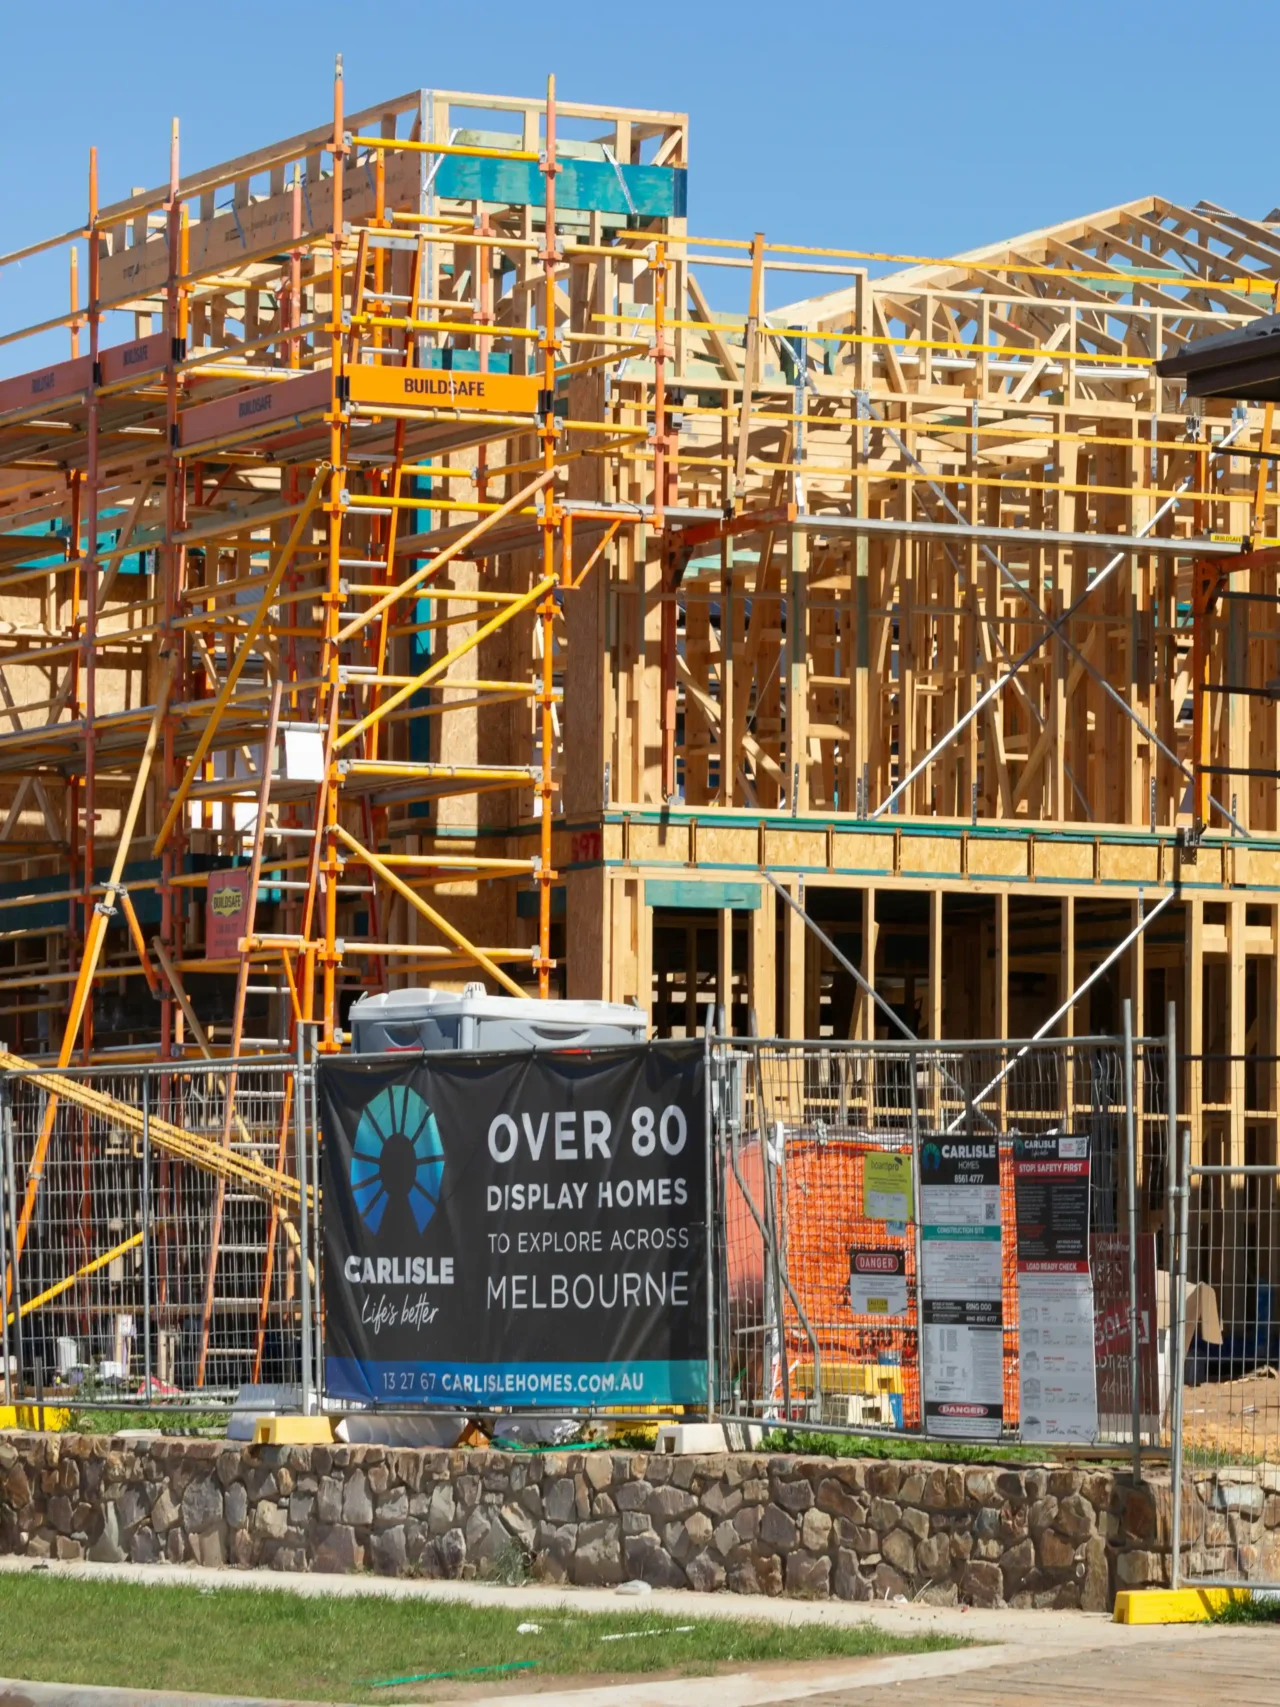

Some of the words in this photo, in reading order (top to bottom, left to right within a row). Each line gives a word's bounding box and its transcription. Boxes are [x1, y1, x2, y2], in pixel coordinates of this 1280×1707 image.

[404, 378, 485, 397] BUILDSAFE
[238, 394, 273, 418] BUILDSAFE
[213, 895, 242, 909] BUILDSAFE
[487, 1110, 612, 1163] OVER
[631, 1104, 687, 1157] 80
[942, 1144, 996, 1159] CARLISLE
[1024, 1140, 1057, 1149] CARLISLE
[958, 1160, 980, 1170] HOMES
[1037, 1163, 1062, 1172] SAFETY
[1063, 1163, 1083, 1172] FIRST
[954, 1174, 968, 1183] 8561
[969, 1174, 984, 1183] 4777
[487, 1183, 588, 1212] DISPLAY
[598, 1178, 688, 1207] HOMES
[488, 1232, 510, 1254] TO
[518, 1230, 603, 1253] EXPLORE
[611, 1228, 689, 1250] ACROSS
[345, 1256, 454, 1284] CARLISLE
[859, 1258, 894, 1269] DANGER
[1026, 1262, 1040, 1271] LOAD
[1040, 1262, 1058, 1271] READY
[1059, 1262, 1077, 1271] CHECK
[487, 1272, 688, 1309] MELBOURNE
[361, 1293, 398, 1335] Life's
[400, 1293, 439, 1331] better
[966, 1303, 979, 1311] RING
[1095, 1354, 1114, 1368] OT
[1117, 1355, 1132, 1368] 25
[384, 1373, 396, 1390] 13
[400, 1373, 415, 1390] 27
[420, 1373, 437, 1390] 67
[442, 1373, 644, 1392] CARLISLEHOMES.COM.AU
[941, 1405, 985, 1415] DANGER
